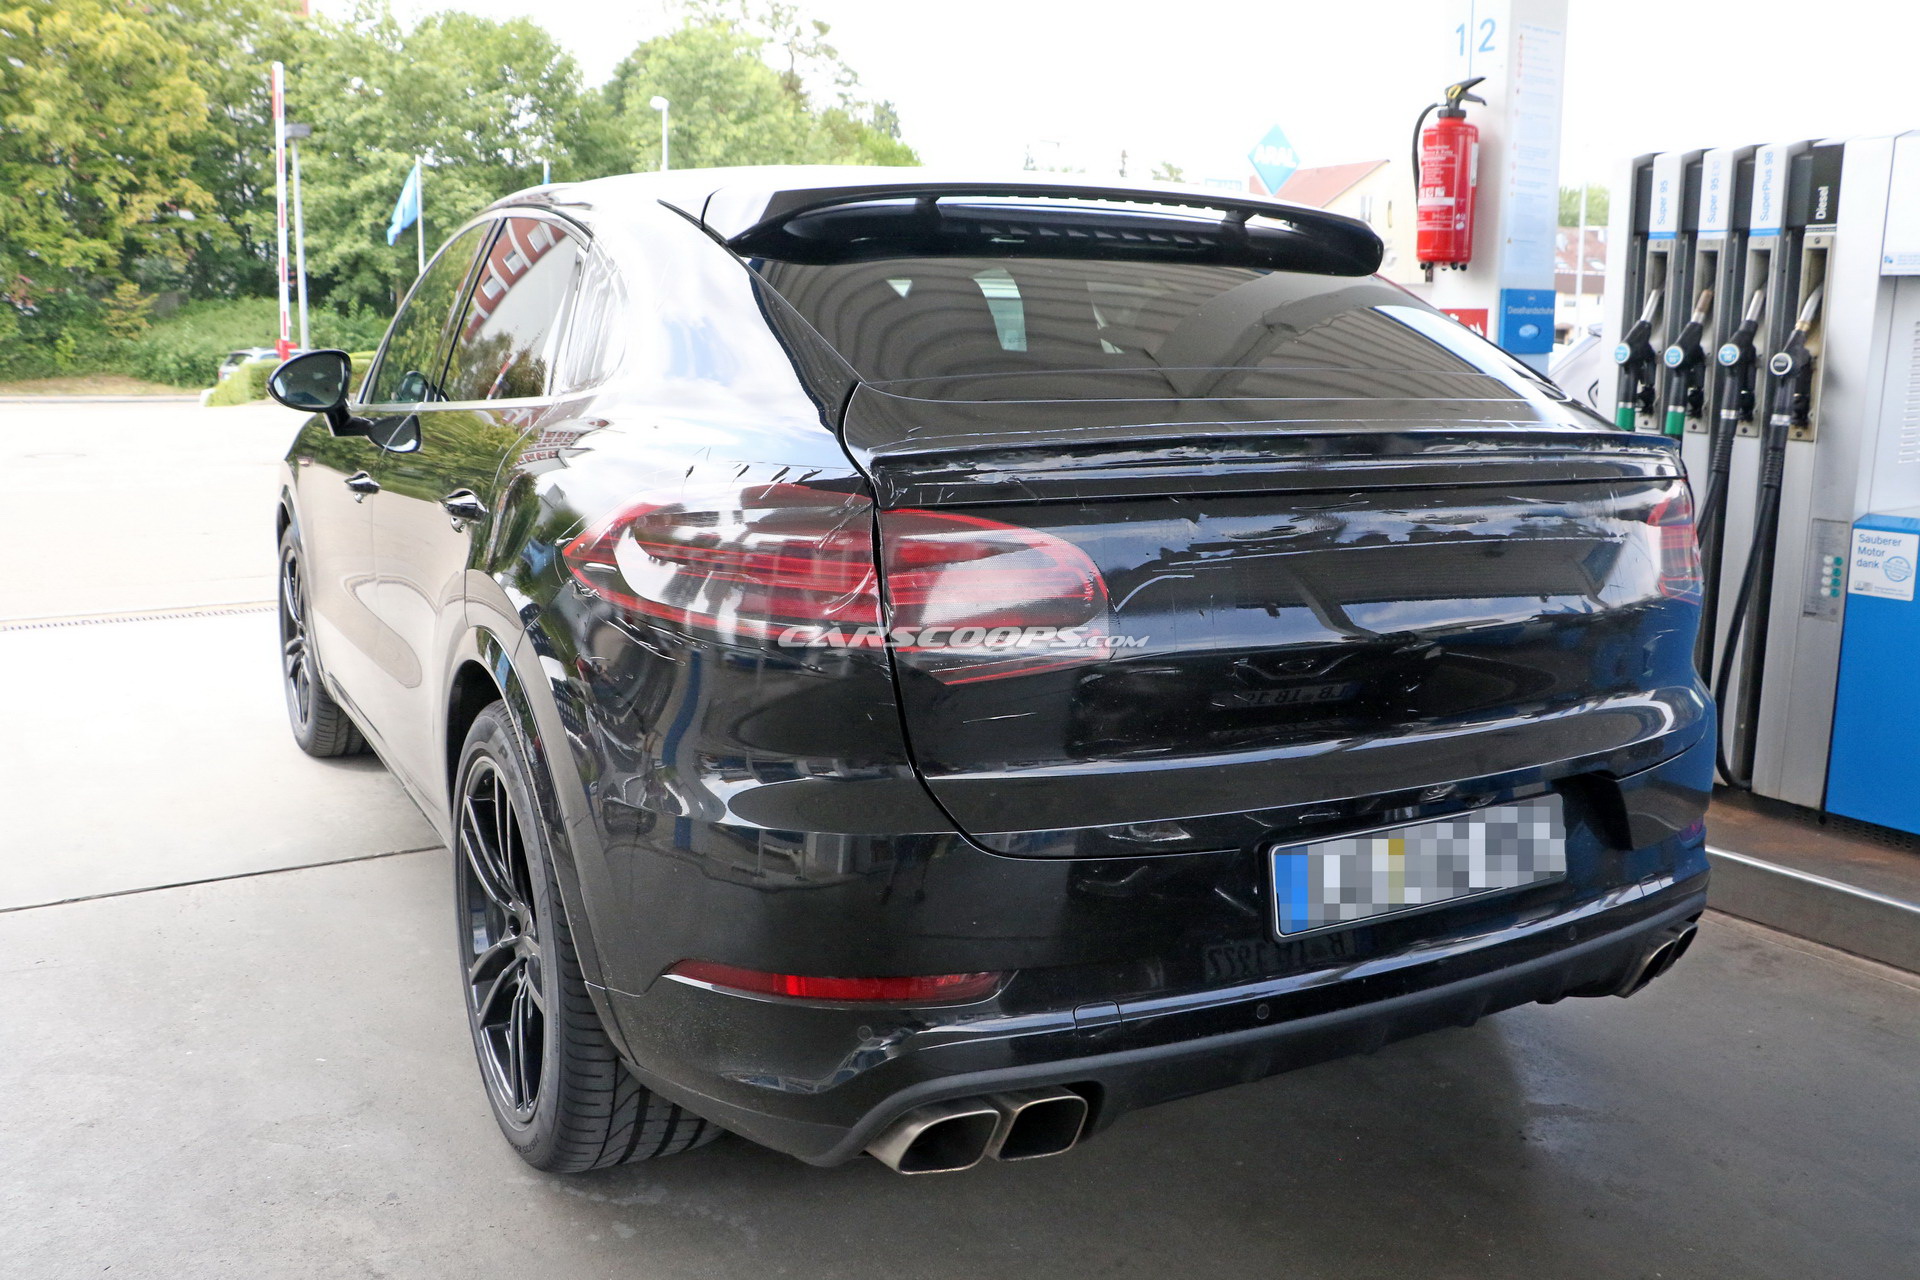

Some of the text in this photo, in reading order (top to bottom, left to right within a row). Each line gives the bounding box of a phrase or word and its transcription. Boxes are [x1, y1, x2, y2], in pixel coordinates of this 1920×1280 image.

[1478, 17, 1497, 53] 2
[1253, 143, 1297, 168] ARAL
[1760, 151, 1774, 222] SuperPlus 98
[1657, 180, 1669, 225] Super 95
[1707, 194, 1718, 224] Super
[1815, 185, 1830, 220] Diesel
[1857, 546, 1886, 557] Motor
[1858, 533, 1902, 547] Sauberer
[1856, 558, 1880, 569] dank
